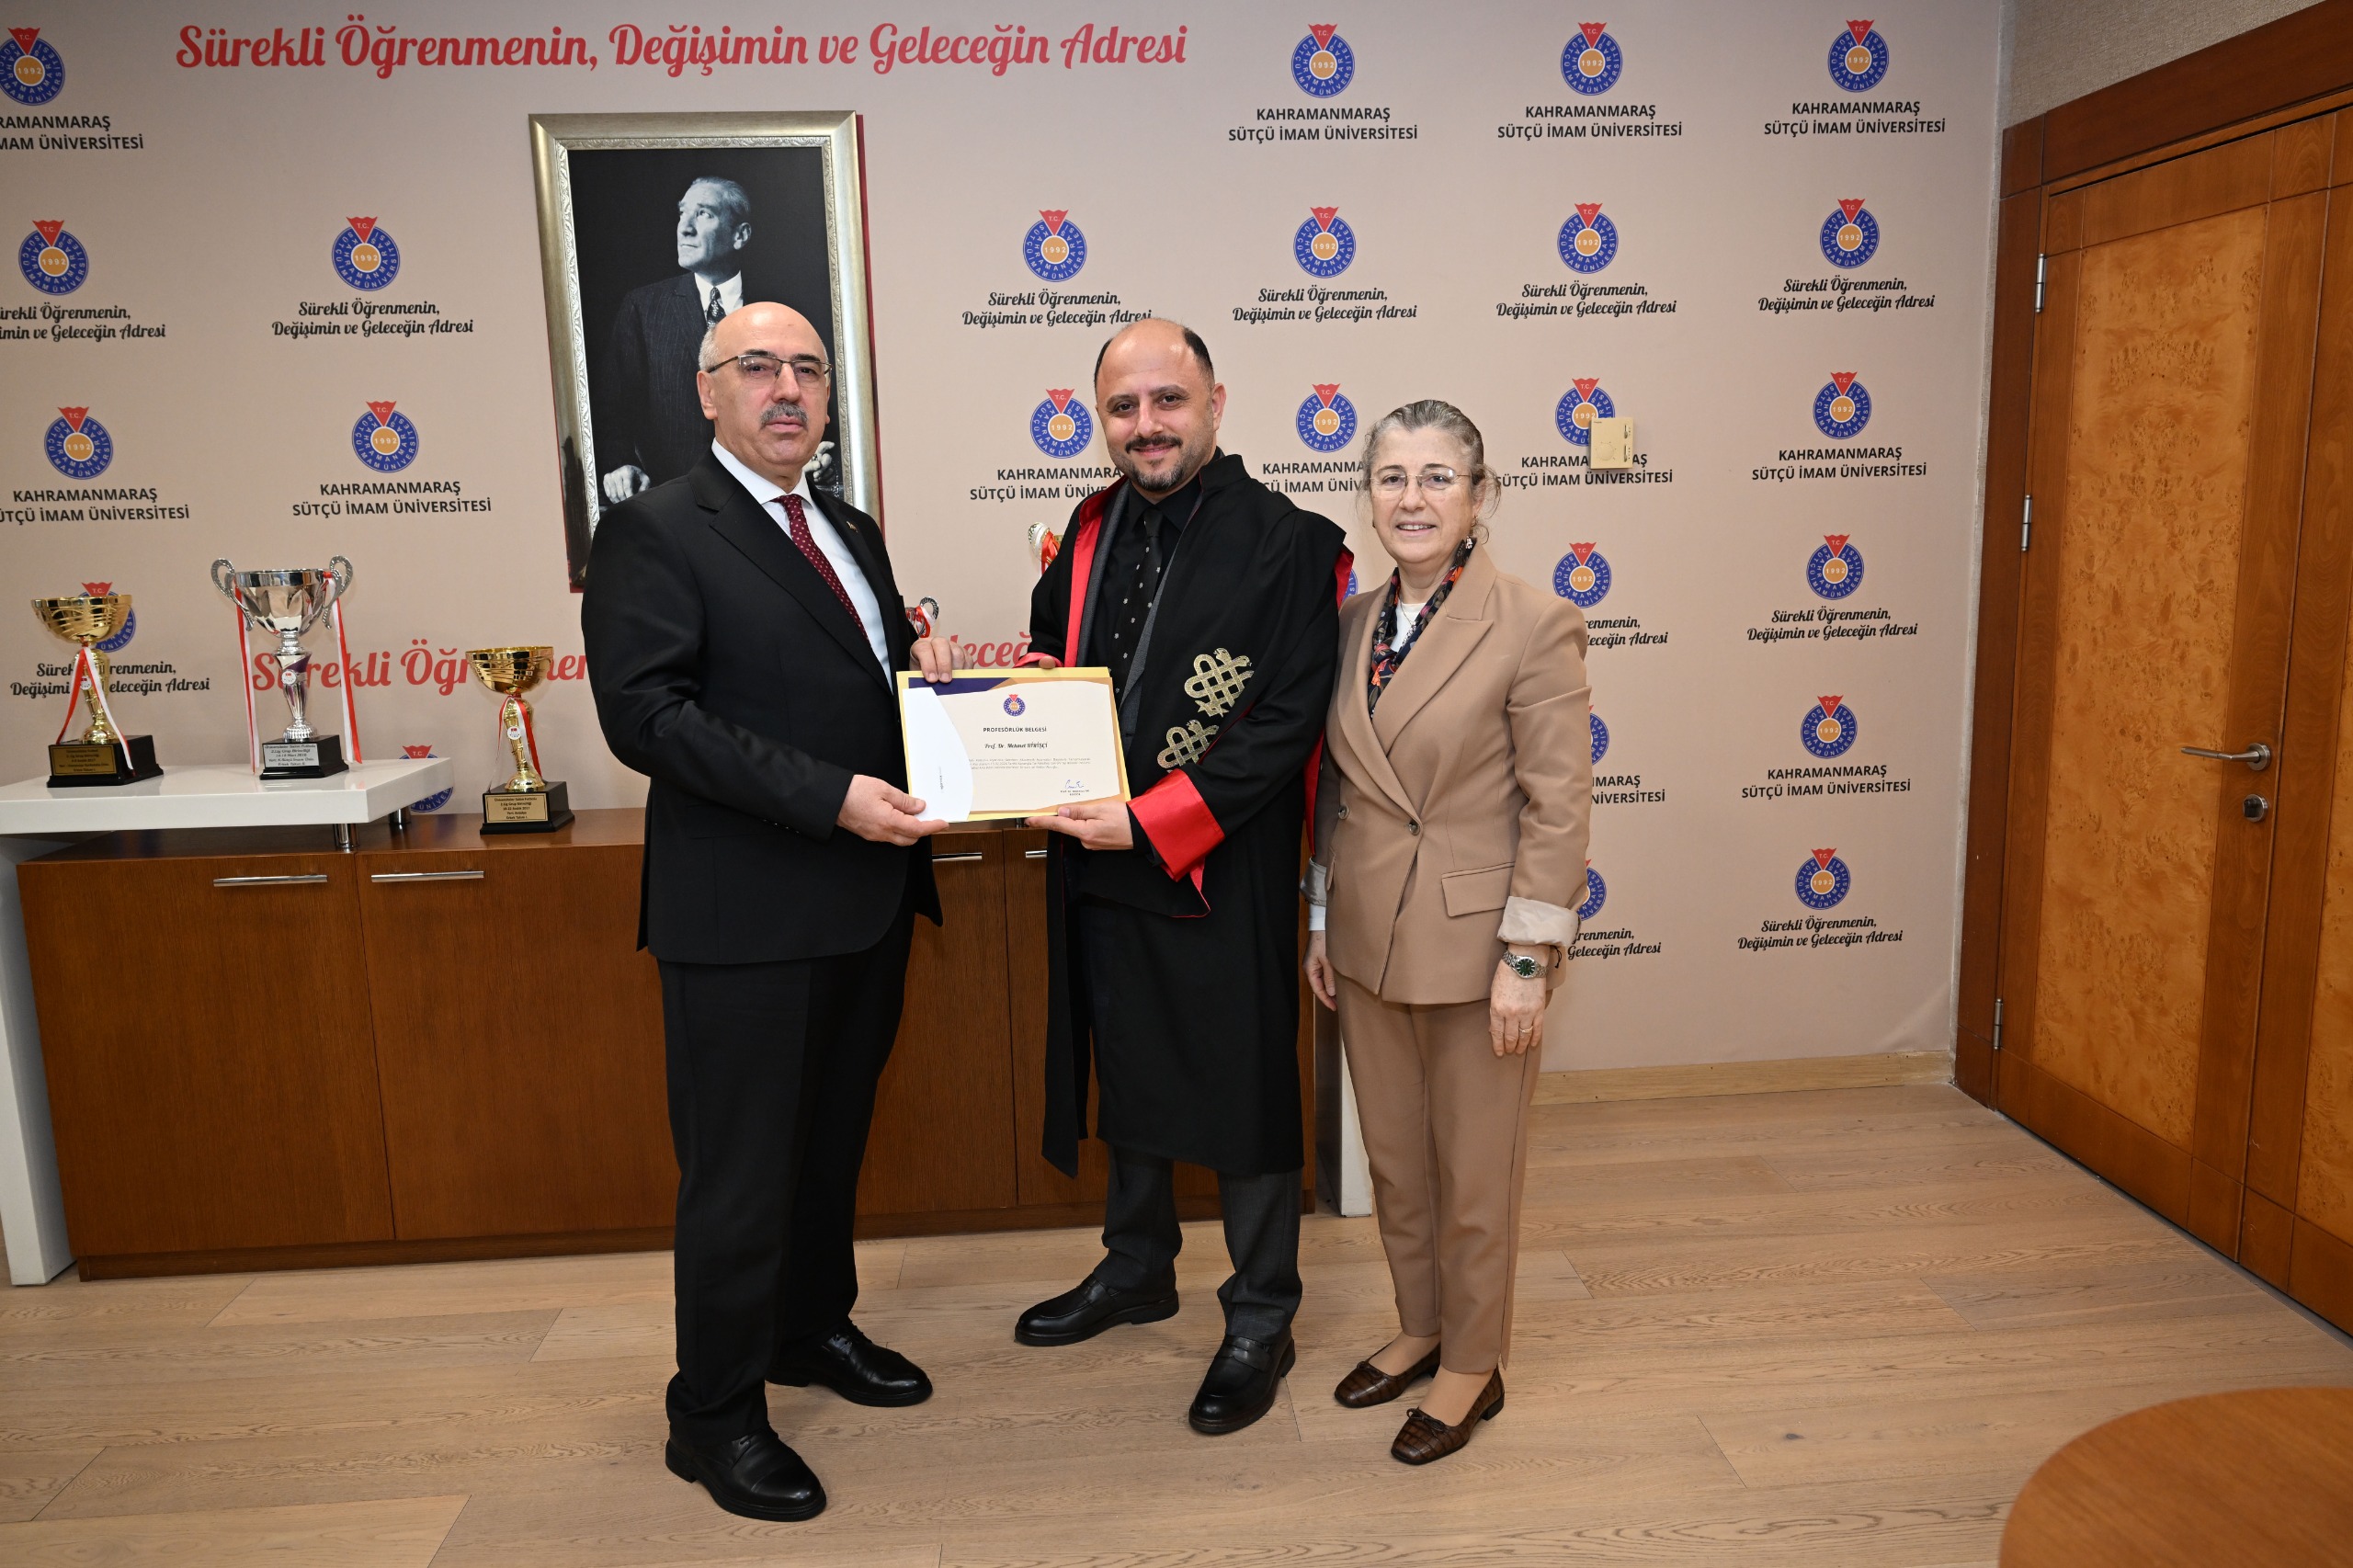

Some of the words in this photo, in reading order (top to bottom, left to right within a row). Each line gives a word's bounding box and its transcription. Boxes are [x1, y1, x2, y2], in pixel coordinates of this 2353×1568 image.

[176, 25, 327, 69] Sürekli
[335, 14, 598, 80] Öğrenmenin,
[608, 23, 810, 78] Değişimin
[818, 35, 859, 65] ve
[869, 21, 1051, 77] Geleceğin
[1060, 22, 1188, 70] Adresi
[17, 67, 43, 75] 1992
[1581, 59, 1603, 67] 1992
[1256, 107, 1391, 123] KAHRAMANMARAŞ
[1526, 104, 1656, 120] KAHRAMANMARAŞ
[1792, 100, 1921, 117] KAHRAMANMARAŞ
[0, 115, 111, 132] RAMANMARAŞ
[1497, 123, 1542, 142] SÜTÇÜ
[1547, 122, 1586, 138] İMAM
[1591, 120, 1682, 138] ÜNİVERSİTESİ
[1764, 119, 1809, 138] SÜTÇÜ
[1813, 119, 1852, 134] İMAM
[1856, 118, 1946, 134] ÜNİVERSİTESİ
[39, 133, 144, 150] ÜNİVERSİTESİ
[1228, 126, 1275, 144] SÜTÇÜ
[1279, 125, 1320, 141] İMAM
[1324, 124, 1417, 141] ÜNİVERSİTESİ
[41, 257, 67, 266] 1992
[354, 254, 379, 262] 1992
[1521, 283, 1567, 298] Sürekli
[1569, 279, 1648, 301] Öğrenmenin,
[1783, 278, 1828, 292] Sürekli
[1830, 274, 1907, 295] Öğrenmenin,
[987, 291, 1036, 306] Sürekli
[1038, 288, 1121, 310] Öğrenmenin,
[1257, 288, 1305, 302] Sürekli
[1307, 284, 1388, 305] Öğrenmenin,
[40, 301, 131, 324] Öğrenmenin,
[298, 301, 348, 316] Sürekli
[351, 297, 440, 320] Öğrenmenin,
[1495, 302, 1558, 320] Değişimin
[1560, 305, 1574, 315] ve
[1575, 301, 1633, 318] Geleceğin
[1635, 300, 1677, 315] Adresi
[1757, 297, 1818, 314] Değişimin
[1820, 300, 1834, 310] ve
[1836, 295, 1893, 312] Geleceğin
[1894, 294, 1936, 310] Adresi
[961, 311, 1028, 329] Değişimin
[1029, 313, 1043, 324] ve
[1046, 310, 1107, 328] Geleceğin
[1232, 307, 1296, 325] Değişimin
[1298, 310, 1312, 320] ve
[1314, 305, 1373, 324] Geleceğin
[1375, 304, 1417, 321] Adresi
[33, 328, 48, 339] ve
[51, 324, 117, 343] Geleceğin
[119, 324, 166, 340] Adresi
[271, 321, 341, 340] Değişimin
[344, 324, 358, 335] ve
[361, 320, 426, 338] Geleceğin
[427, 319, 473, 335] Adresi
[1574, 412, 1597, 420] 1992
[67, 443, 92, 451] 1992
[374, 437, 398, 445] 1992
[1521, 453, 1648, 468] KAHRAMAAŞ
[1779, 447, 1903, 461] KAHRAMANMARAŞ
[997, 467, 1122, 481] KAHRAMANMARA
[1262, 461, 1363, 474] KAHRAMANMA
[1752, 466, 1795, 483] SÜTÇÜ
[1799, 465, 1836, 479] İMAM
[1840, 461, 1927, 478] ÜNİVERSİTESİ
[1284, 479, 1324, 493] İMAM
[1542, 472, 1580, 486] İMAM
[1585, 468, 1673, 485] ÜNİVERSİTESİ
[13, 487, 158, 504] KAHRAMANMARAŞ
[320, 481, 461, 496] KAHRAMANMARAŞ
[970, 488, 1016, 503] SÜTÇÜ
[1020, 484, 1061, 499] İMAM
[40, 506, 85, 522] İMAM
[88, 504, 189, 521] ÜNİVERSİTESİ
[292, 500, 341, 519] SÜTÇÜ
[345, 500, 389, 515] İMAM
[392, 496, 492, 514] ÜNİVERSİTESİ
[1586, 616, 1640, 629] enmenin,
[1771, 609, 1815, 623] Sürekli
[1816, 605, 1892, 625] Öğrenmenin,
[1629, 631, 1668, 646] Adresi
[1746, 627, 1805, 644] Değişimin
[1807, 629, 1821, 639] ve
[1823, 624, 1877, 642] Geleceğin
[1879, 622, 1918, 638] Adresi
[109, 661, 176, 675] renmenin,
[252, 651, 392, 691] Srekli
[10, 681, 70, 699] Değişimi
[109, 679, 161, 697] eleceğin
[165, 677, 210, 693] Adresi
[1768, 765, 1887, 780] KAHRAMANMARAŞ
[1591, 789, 1665, 804] NİVERSİTESİ
[1741, 784, 1783, 801] SÜTÇÜ
[1787, 782, 1824, 796] İMAM
[1827, 778, 1911, 795] ÜNİVERSİTESİ
[1576, 927, 1634, 941] renmenin,
[1760, 919, 1803, 933] Sürekli
[1804, 915, 1877, 936] Öğrenmenin,
[1737, 936, 1794, 952] Değişimin
[1796, 937, 1809, 947] ve
[1811, 932, 1863, 949] Geleceğin
[1865, 929, 1904, 945] Adresi
[1567, 944, 1620, 960] Geleceğin
[1623, 942, 1662, 957] Adresi
